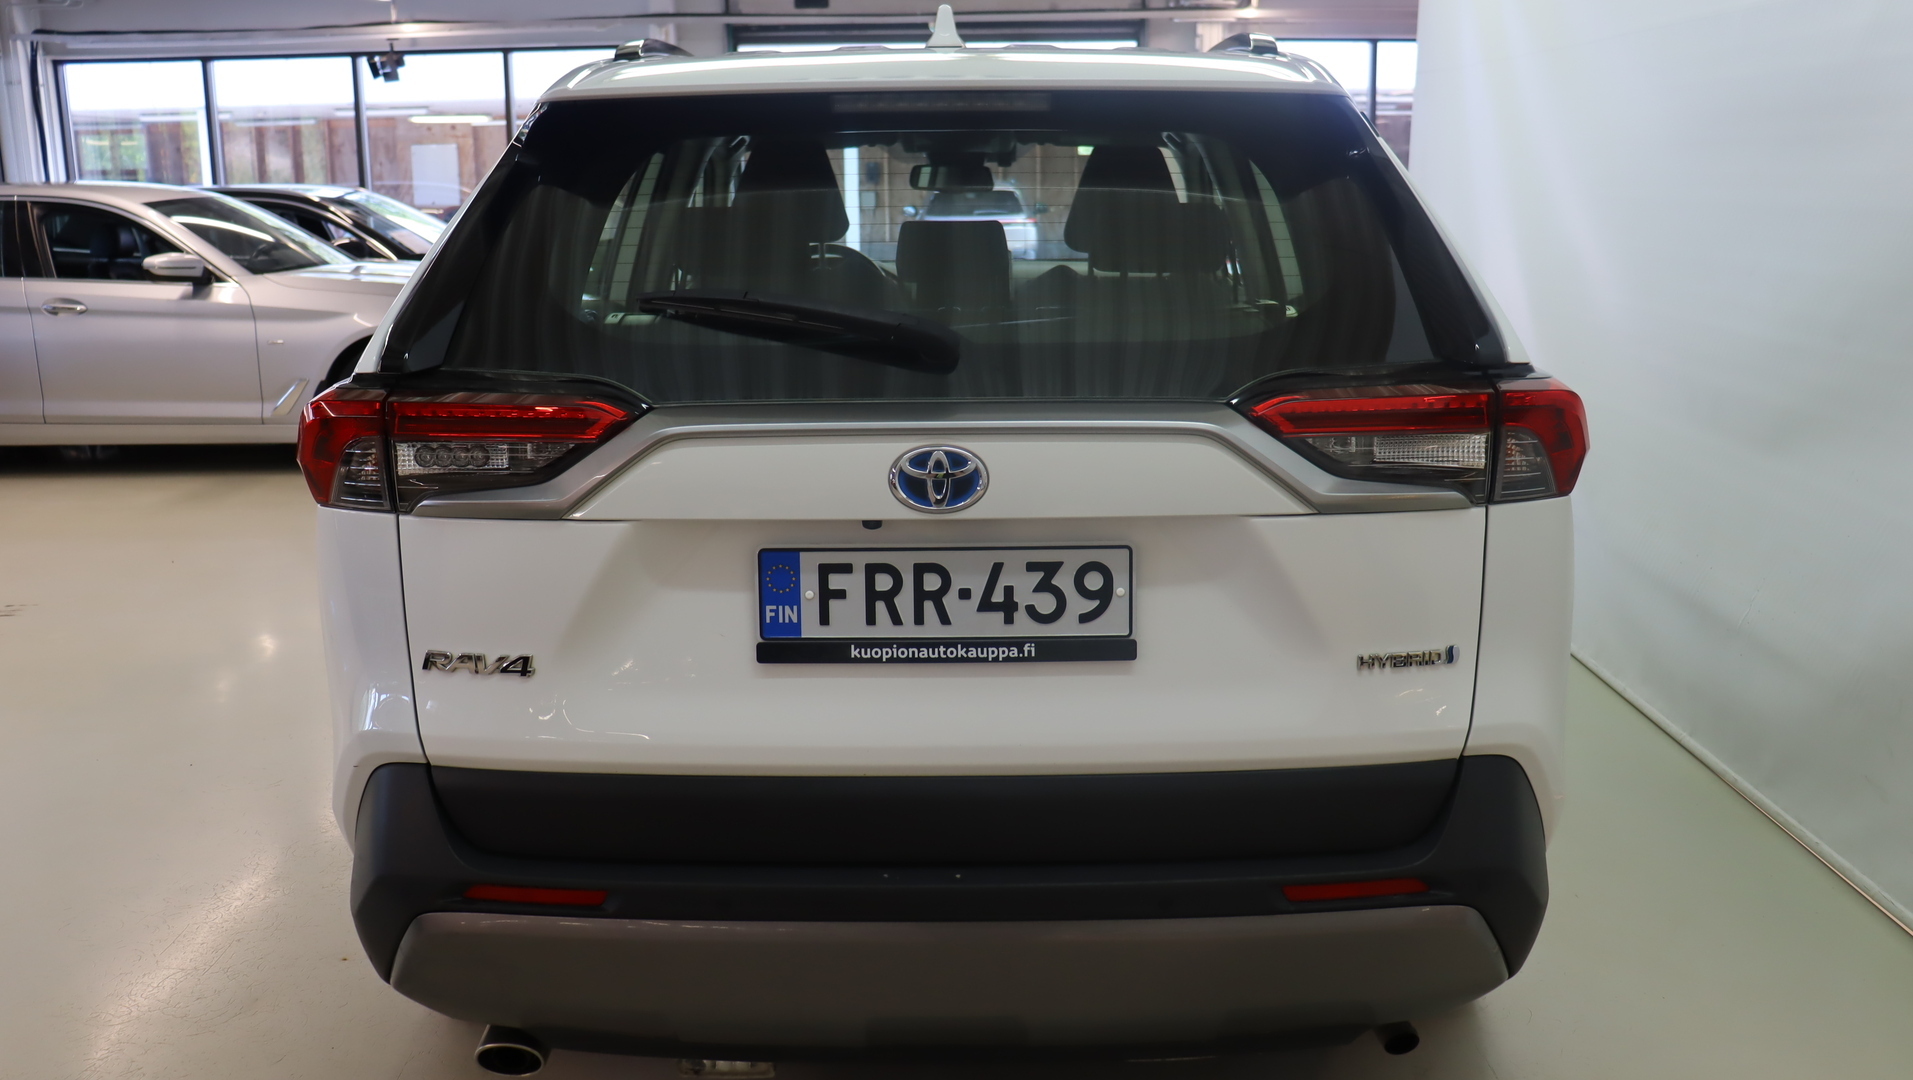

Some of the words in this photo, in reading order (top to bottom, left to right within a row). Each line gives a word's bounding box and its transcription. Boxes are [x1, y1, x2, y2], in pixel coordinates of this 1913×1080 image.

[765, 605, 798, 623] FIN
[850, 643, 1036, 662] kuopionautokauppa.fi
[1357, 649, 1444, 671] HYBRID
[422, 649, 535, 678] RAV4
